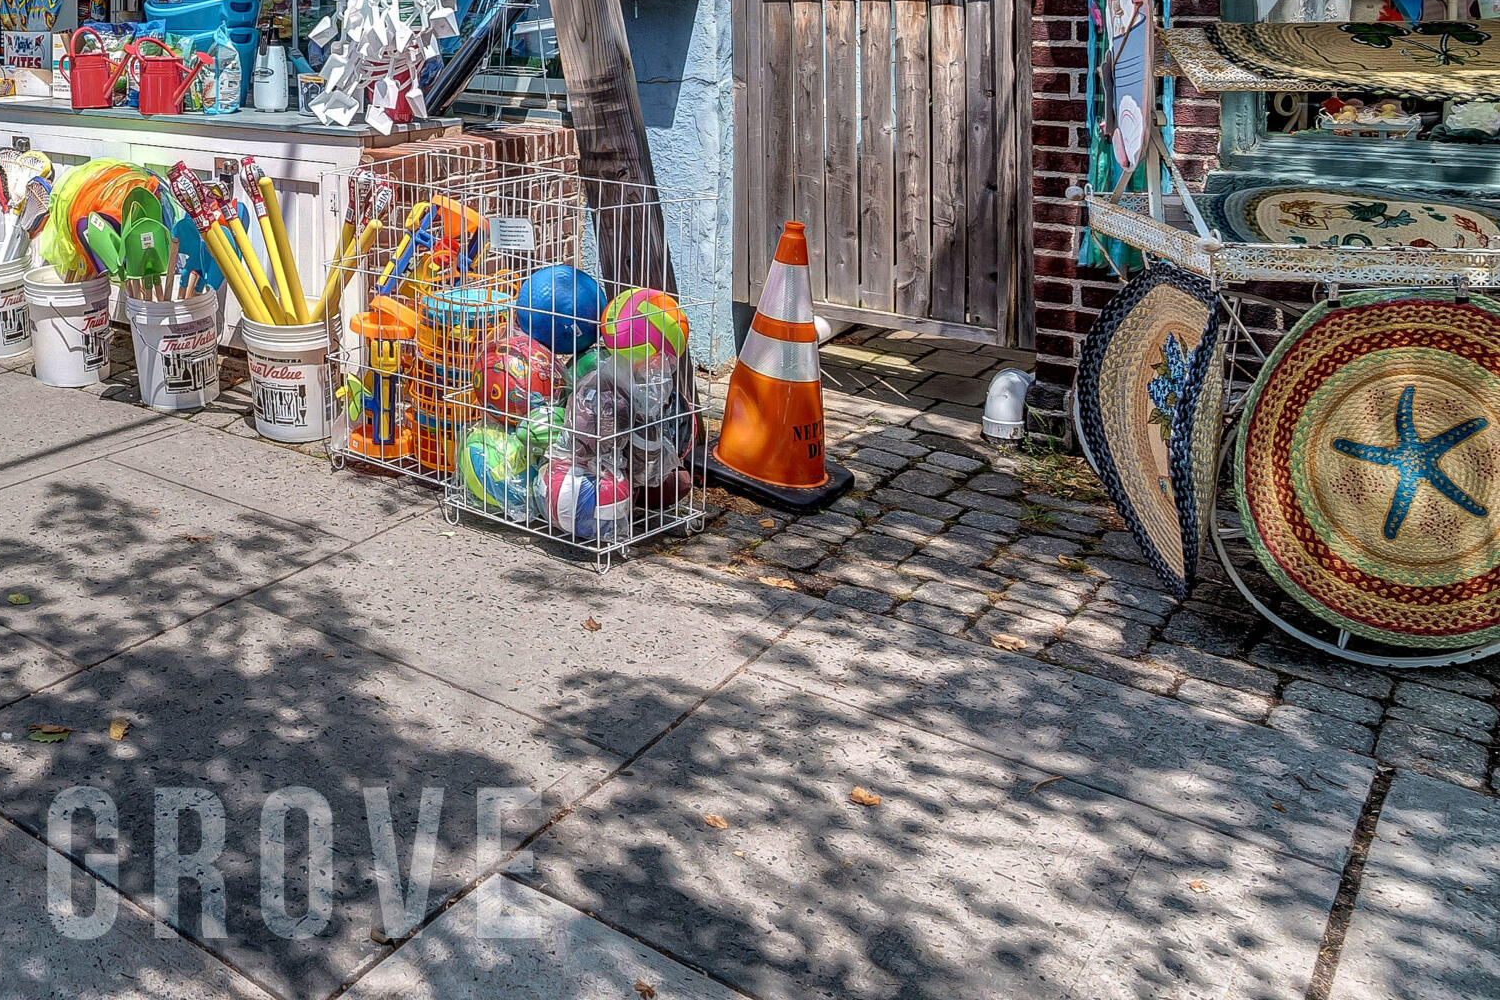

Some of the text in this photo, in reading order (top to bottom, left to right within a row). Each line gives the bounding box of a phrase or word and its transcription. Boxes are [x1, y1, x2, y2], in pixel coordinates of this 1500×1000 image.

[9, 56, 42, 69] KITES
[161, 339, 190, 353] True
[257, 362, 302, 379] Value
